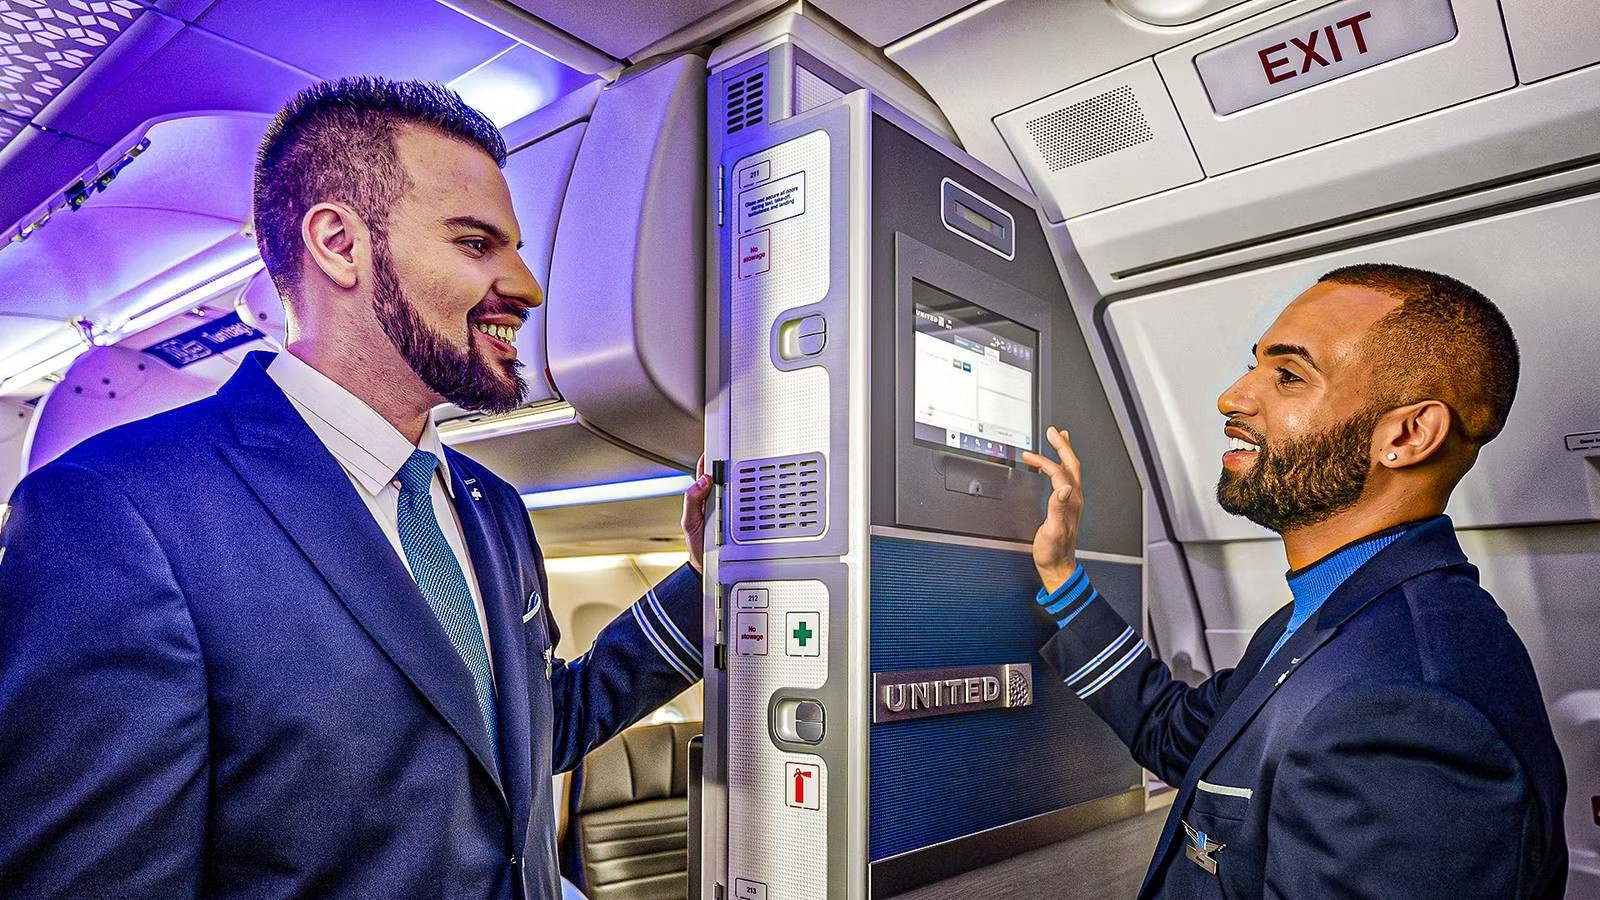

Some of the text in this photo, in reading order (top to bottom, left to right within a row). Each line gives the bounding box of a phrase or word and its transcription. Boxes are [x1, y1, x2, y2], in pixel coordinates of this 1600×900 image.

[1258, 11, 1372, 85] EXIT
[750, 170, 759, 178] 211
[743, 252, 766, 263] stowage
[916, 309, 938, 323] UNITED
[884, 676, 1000, 712] UNITED
[746, 886, 757, 894] 213
